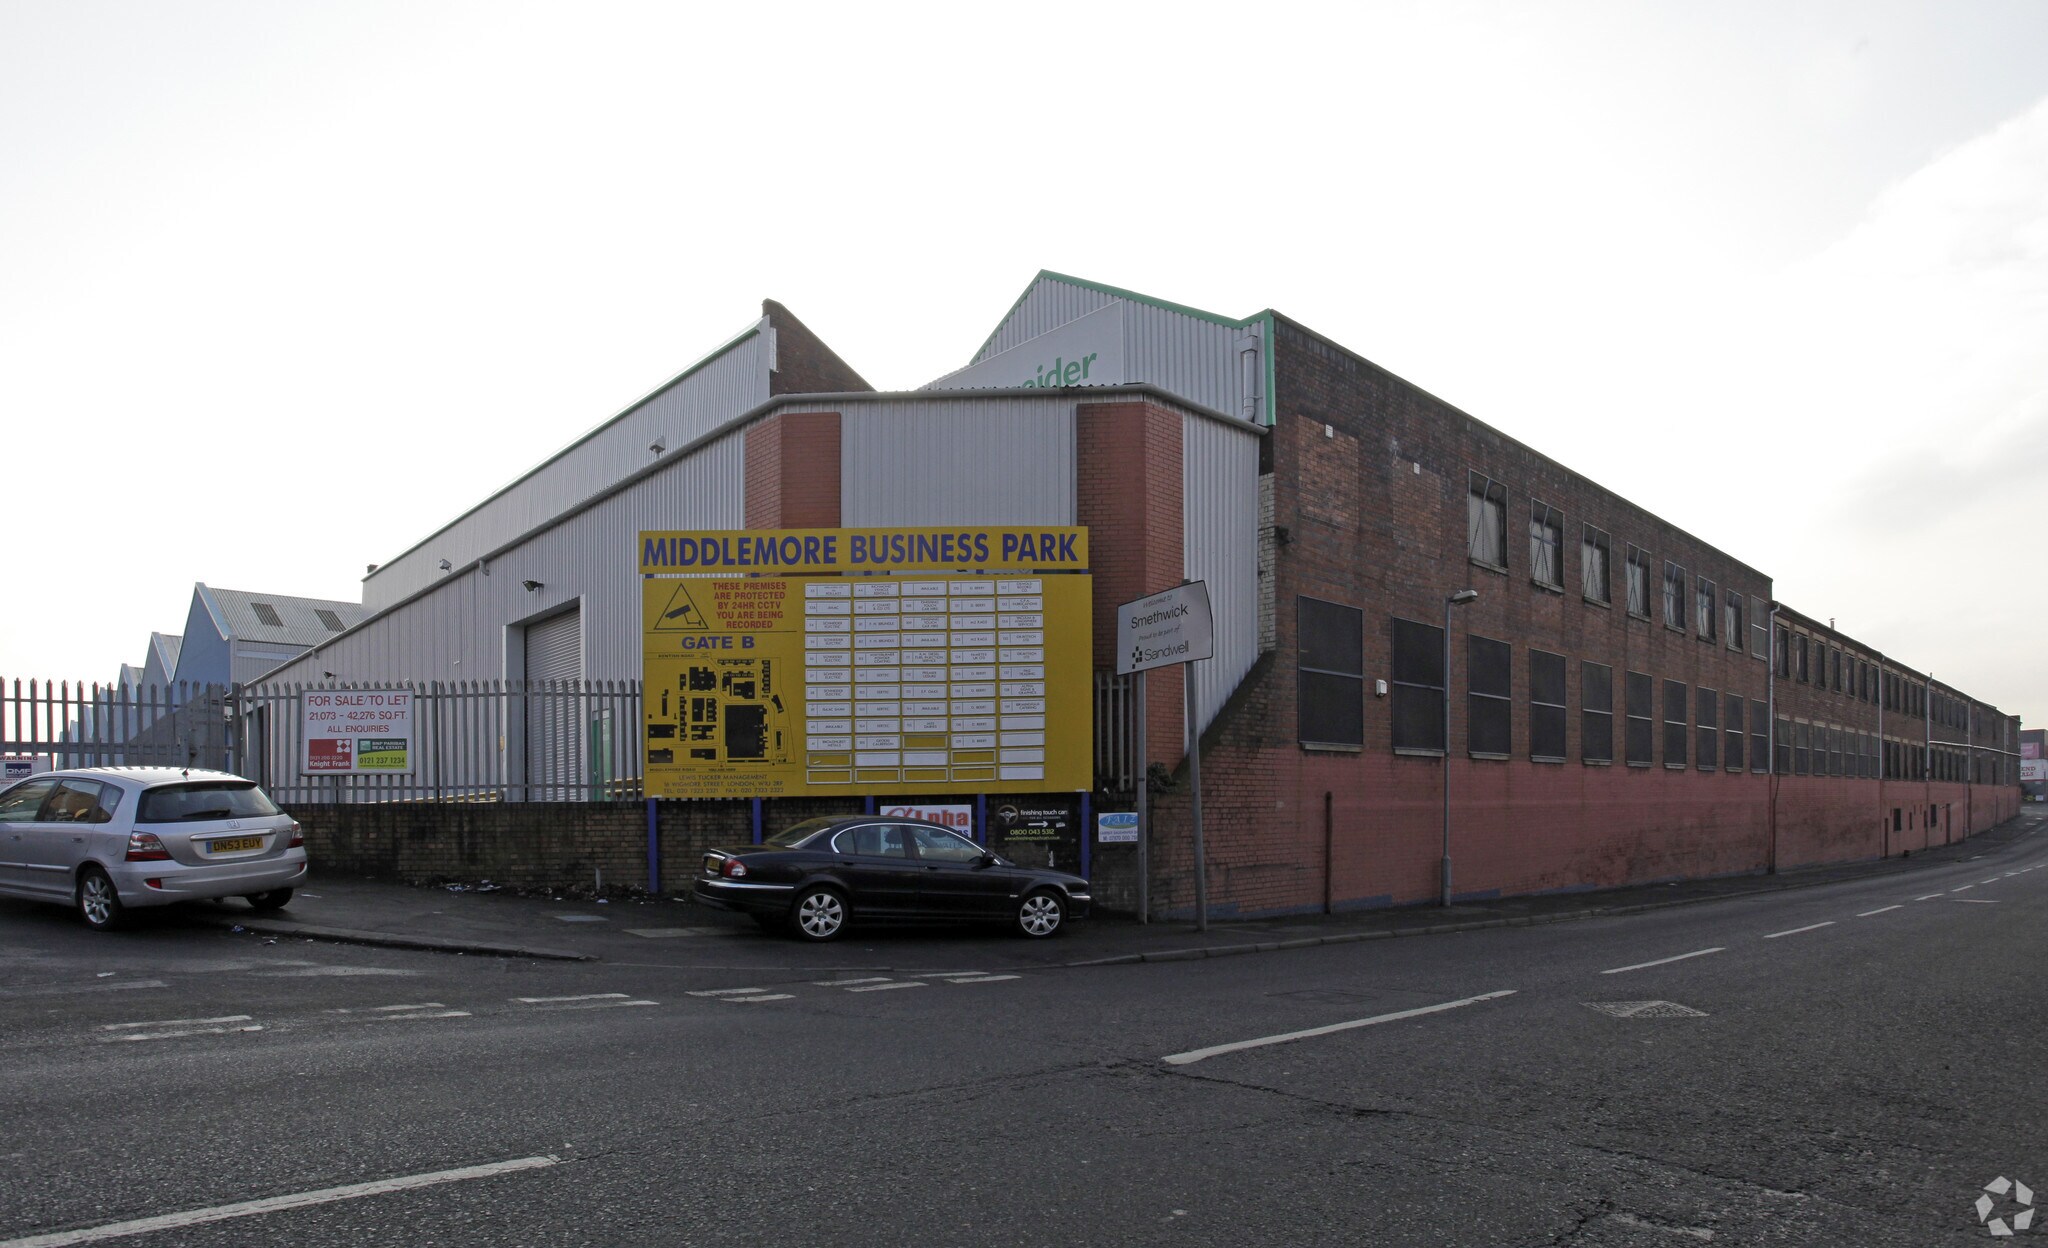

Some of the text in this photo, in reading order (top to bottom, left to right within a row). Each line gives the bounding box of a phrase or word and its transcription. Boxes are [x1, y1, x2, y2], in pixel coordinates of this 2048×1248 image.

[643, 532, 1079, 567] MIDDLEMORE BUSINESS PARK
[713, 582, 786, 590] THESE PREMISES
[714, 591, 786, 600] ARE PROTECTED
[718, 601, 781, 610] BY 24HR CCTV
[716, 611, 784, 619] YOU ARE BEING
[1131, 603, 1189, 629] Smethwick
[726, 620, 773, 629] RECORDED
[681, 636, 755, 650] GATE B
[1144, 640, 1189, 661] Sandwell
[308, 695, 408, 706] FOR SALE/TO LET
[309, 711, 336, 721] 21,073
[347, 711, 375, 721] 42,276
[378, 711, 408, 720] SQ.FT.
[327, 725, 390, 733] ALL ENQUIRIES
[309, 760, 330, 769] Knight
[213, 837, 261, 851] DN53 EUY
